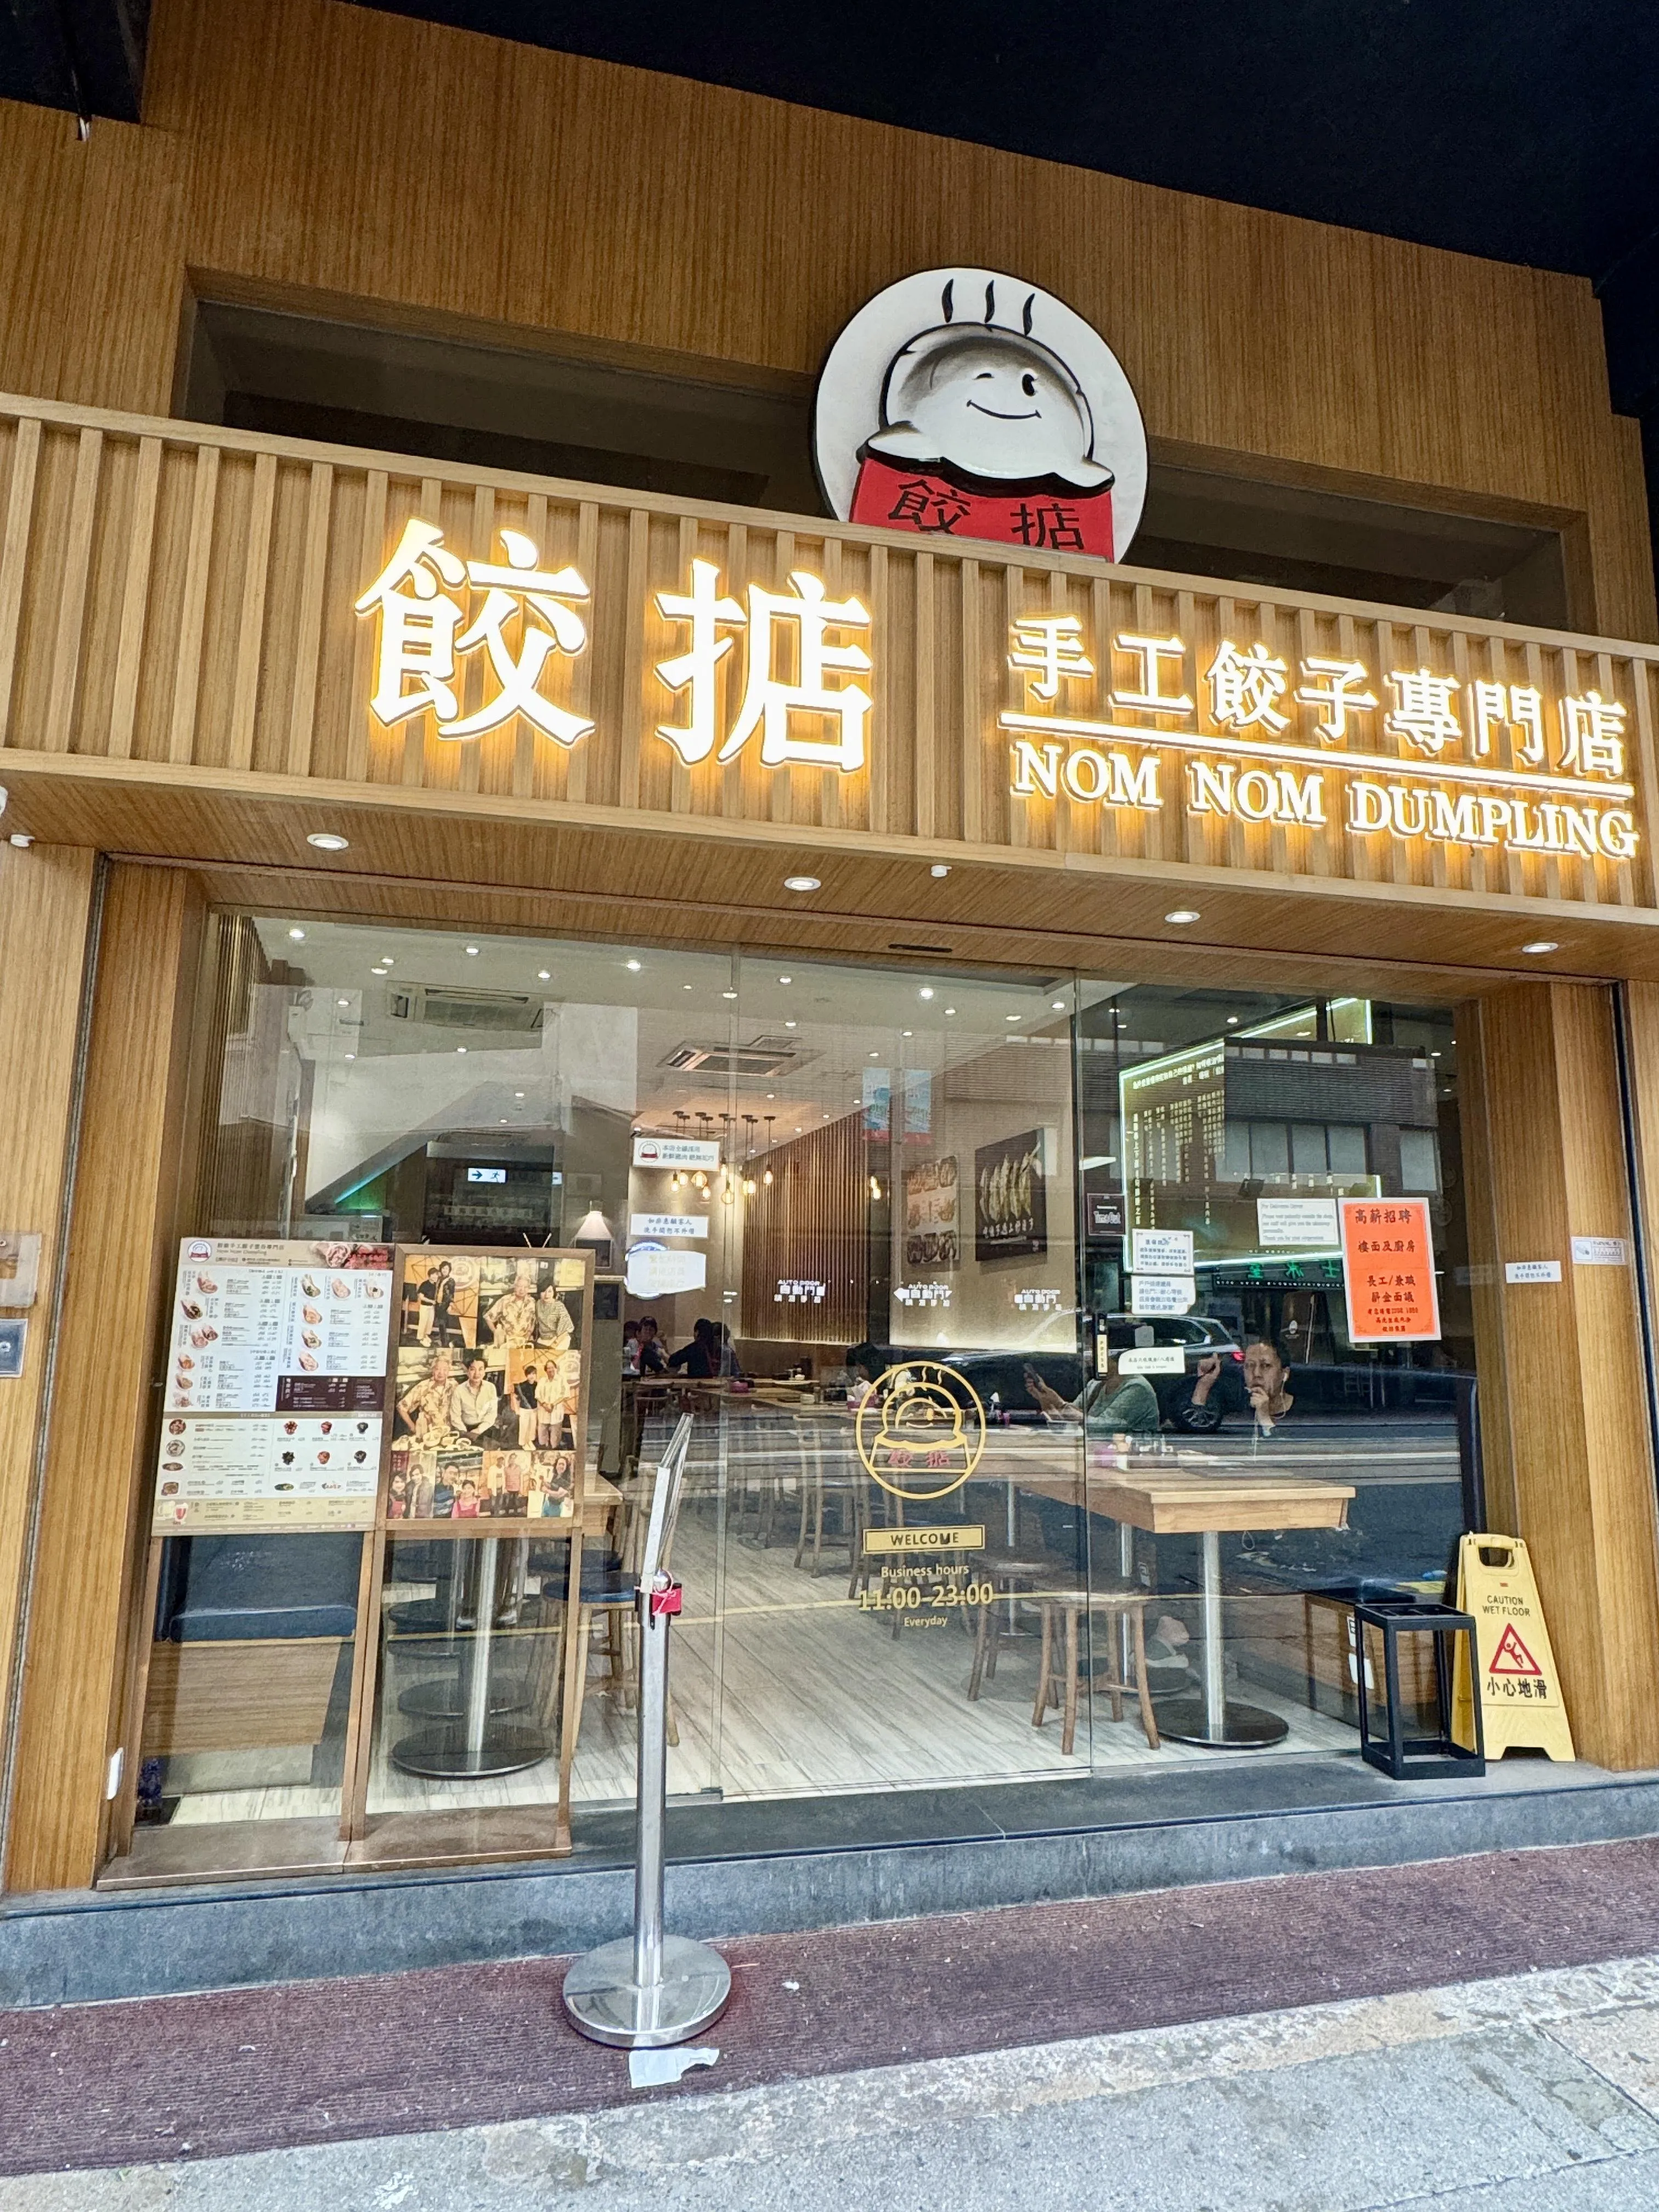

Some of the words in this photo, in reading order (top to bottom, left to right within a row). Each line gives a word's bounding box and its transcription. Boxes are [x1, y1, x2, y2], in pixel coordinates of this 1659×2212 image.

[354, 517, 873, 774] 餃掂
[1007, 614, 1627, 779] 手工餃子專門店
[1011, 739, 1164, 810] NOM
[1187, 759, 1327, 827] NOM
[1346, 779, 1640, 859] DUMPLING
[1355, 1208, 1412, 1224] 高薪招聘
[890, 1532, 960, 1546] WELCOME
[881, 1565, 932, 1578] Business
[935, 1563, 969, 1576] hours
[1487, 1595, 1523, 1605] CAUTION
[1482, 1605, 1500, 1615] WET
[1502, 1606, 1531, 1617] FLOOR
[904, 1616, 948, 1628] Everyday
[1486, 1677, 1548, 1700] 小心地滑
